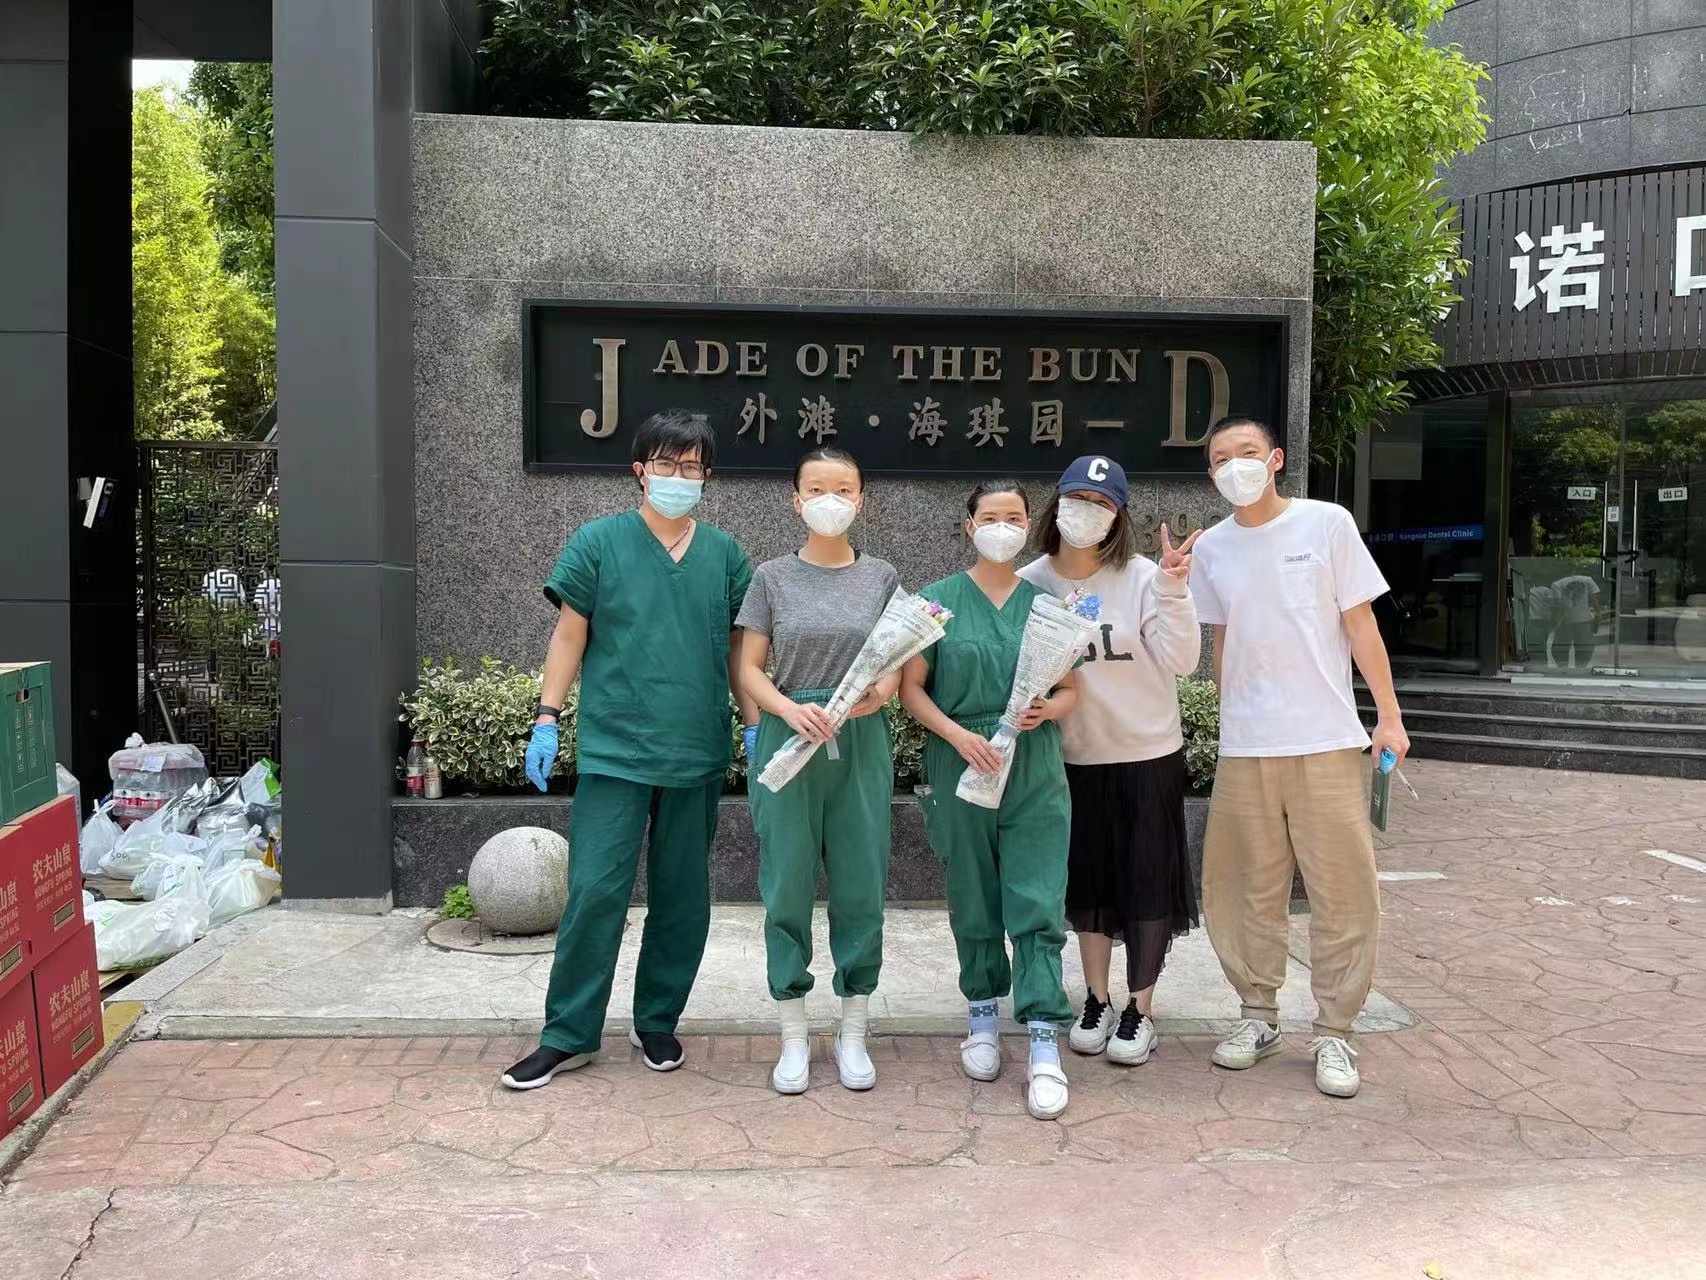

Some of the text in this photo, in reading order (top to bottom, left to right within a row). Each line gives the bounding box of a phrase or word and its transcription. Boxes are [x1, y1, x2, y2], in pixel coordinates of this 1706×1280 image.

[580, 338, 767, 437] JADE
[796, 343, 864, 379] OF
[892, 345, 1001, 382] THE
[1087, 457, 1110, 482] C
[1572, 489, 1592, 498] 入口
[1663, 489, 1683, 499] 出口
[1428, 531, 1450, 539] Dental
[1451, 529, 1474, 538] Clinic
[32, 842, 72, 884] 农夫山泉
[34, 866, 73, 899] NONGFU SPRING
[49, 969, 90, 1017] 农夫山泉
[51, 1008, 73, 1033] NONGFU
[73, 991, 92, 1014] SPRING
[7, 1044, 29, 1069] SPRING
